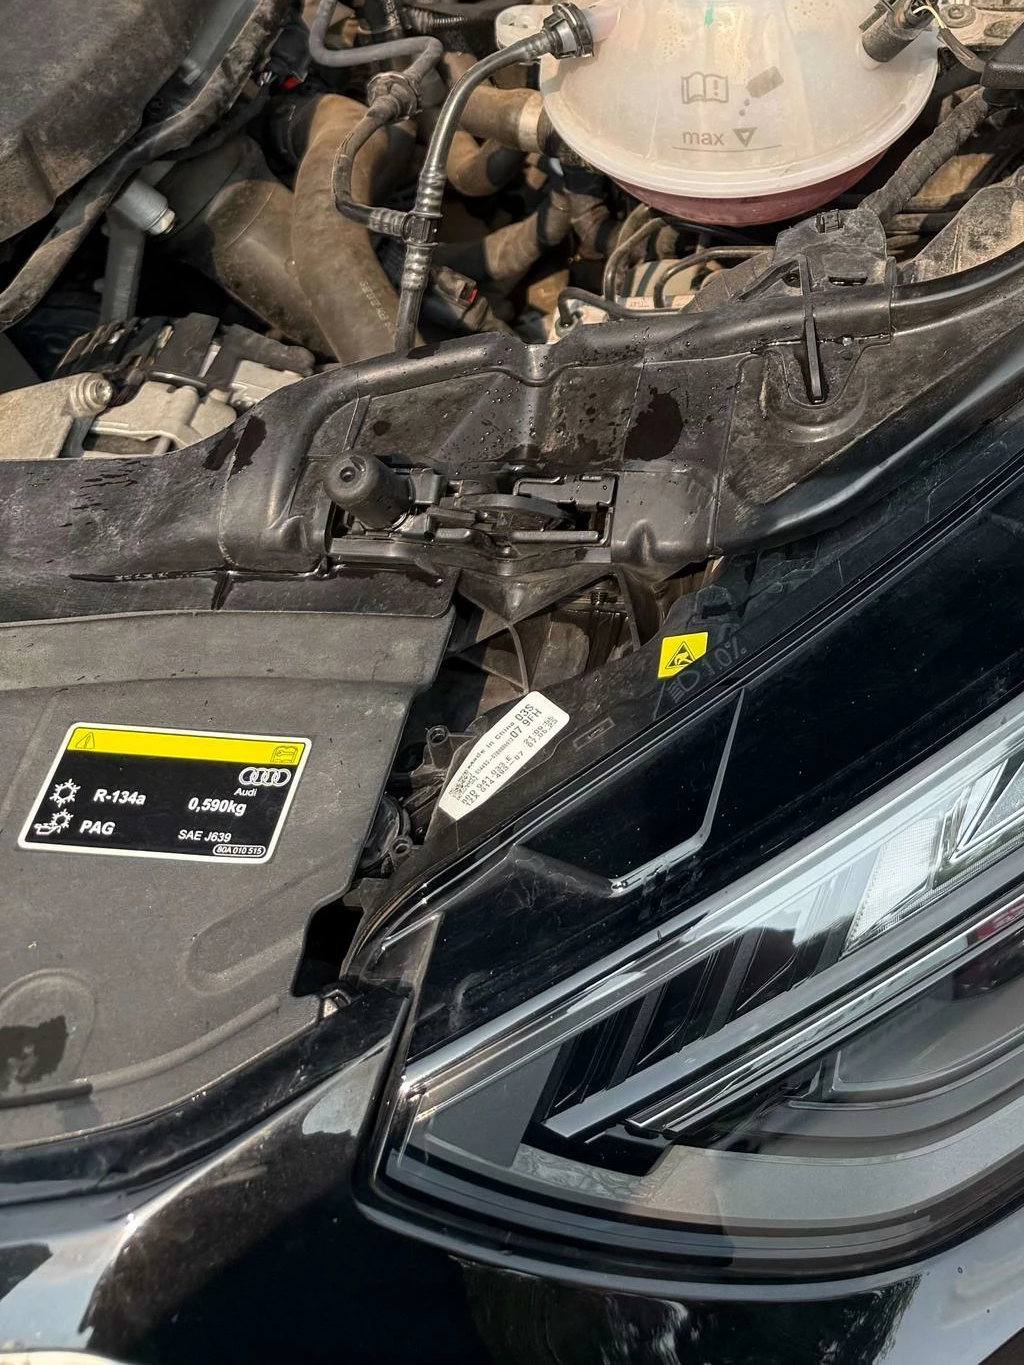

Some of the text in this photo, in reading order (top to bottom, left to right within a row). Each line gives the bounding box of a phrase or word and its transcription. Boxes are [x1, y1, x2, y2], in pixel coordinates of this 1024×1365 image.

[682, 131, 725, 146] max
[486, 740, 495, 748] in
[514, 703, 533, 722] 03S
[509, 709, 542, 739] 07 9FH
[233, 787, 258, 797] Audi
[93, 788, 247, 817] R-134a 0,590kg
[79, 819, 116, 835] PAG
[177, 829, 232, 843] SAE J639
[232, 847, 247, 855] 010
[247, 847, 262, 855] 515
